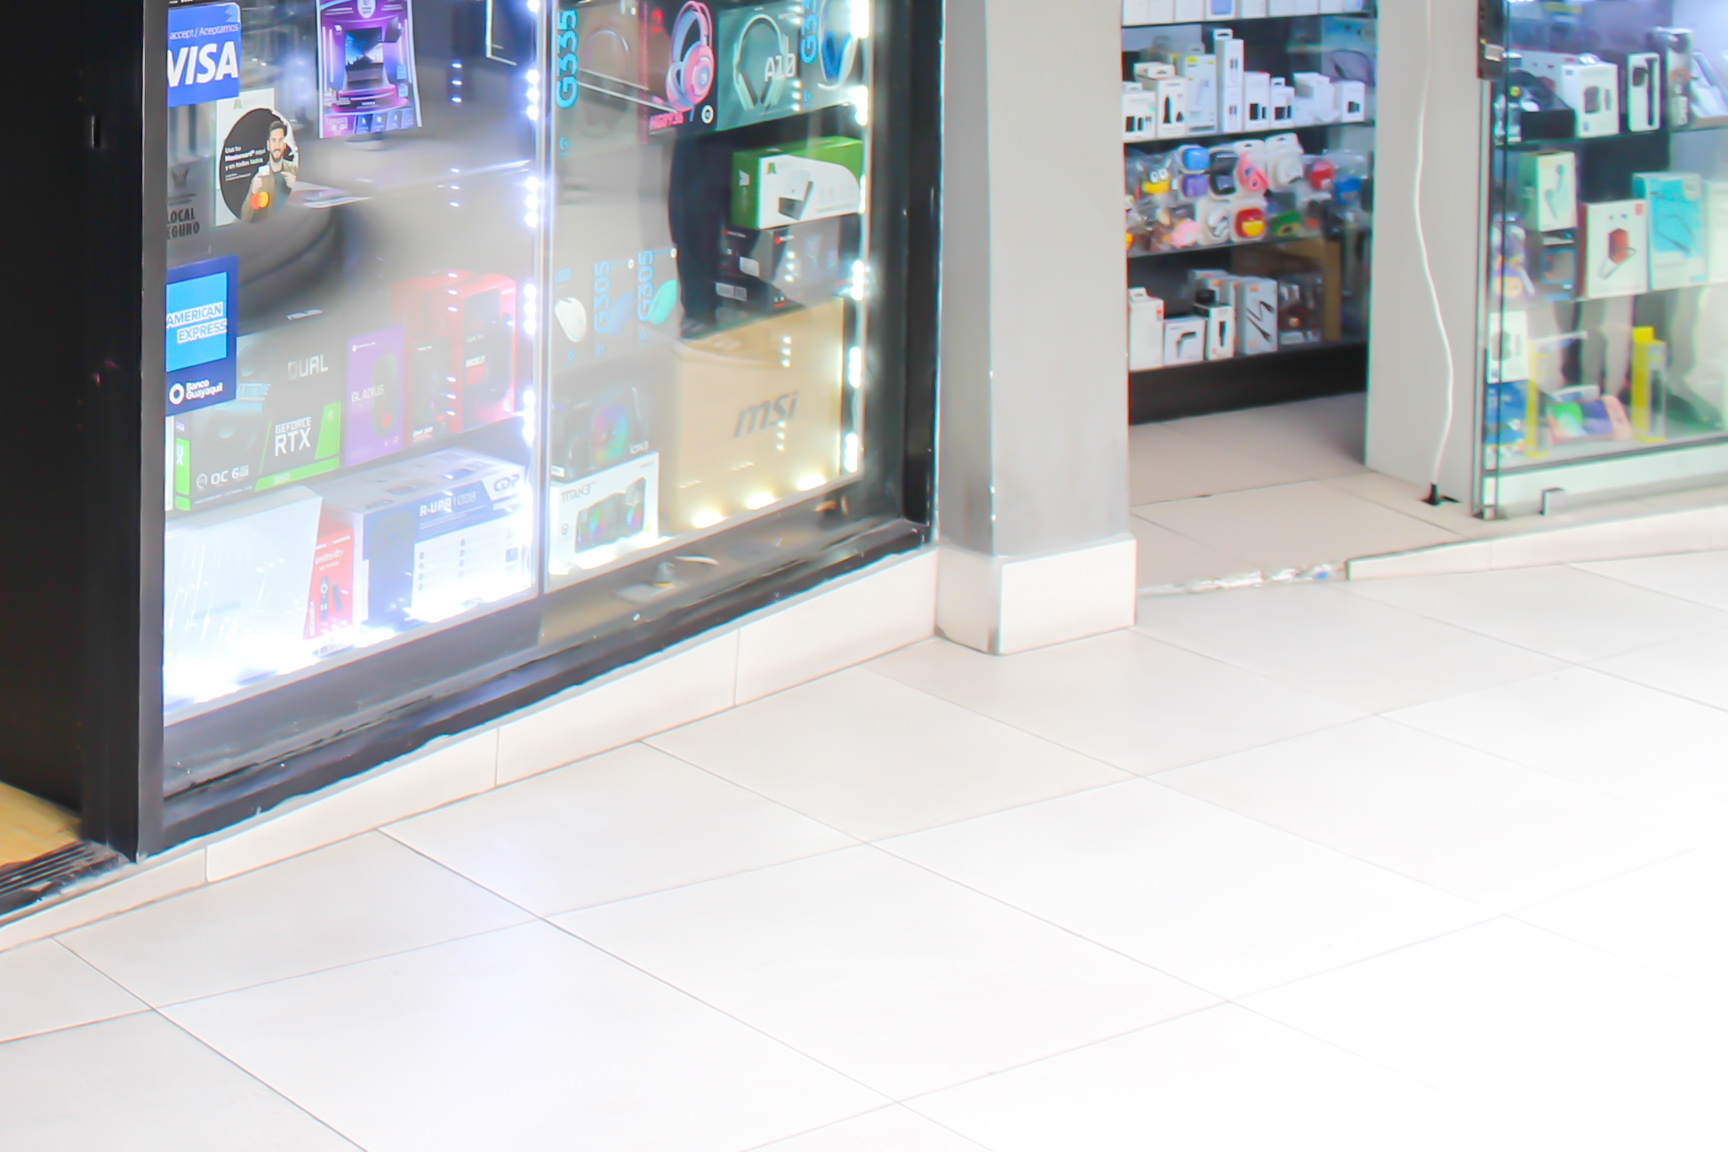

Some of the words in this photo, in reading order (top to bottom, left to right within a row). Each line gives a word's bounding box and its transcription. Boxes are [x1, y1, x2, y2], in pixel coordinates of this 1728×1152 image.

[199, 23, 239, 36] Aceptamos
[167, 41, 239, 88] VISA
[555, 9, 579, 110] G335
[167, 208, 195, 223] OCAL
[593, 260, 611, 334] G305
[637, 249, 655, 322] G305
[167, 303, 222, 327] AMERICAN
[177, 321, 228, 343] EXPRESS
[287, 354, 329, 380] DUAL
[186, 379, 210, 391] Banco
[186, 382, 223, 400] Guayaquil
[275, 416, 312, 434] GEFORCE
[734, 391, 801, 439] msi
[274, 427, 311, 457] RTX
[210, 470, 229, 485] OC
